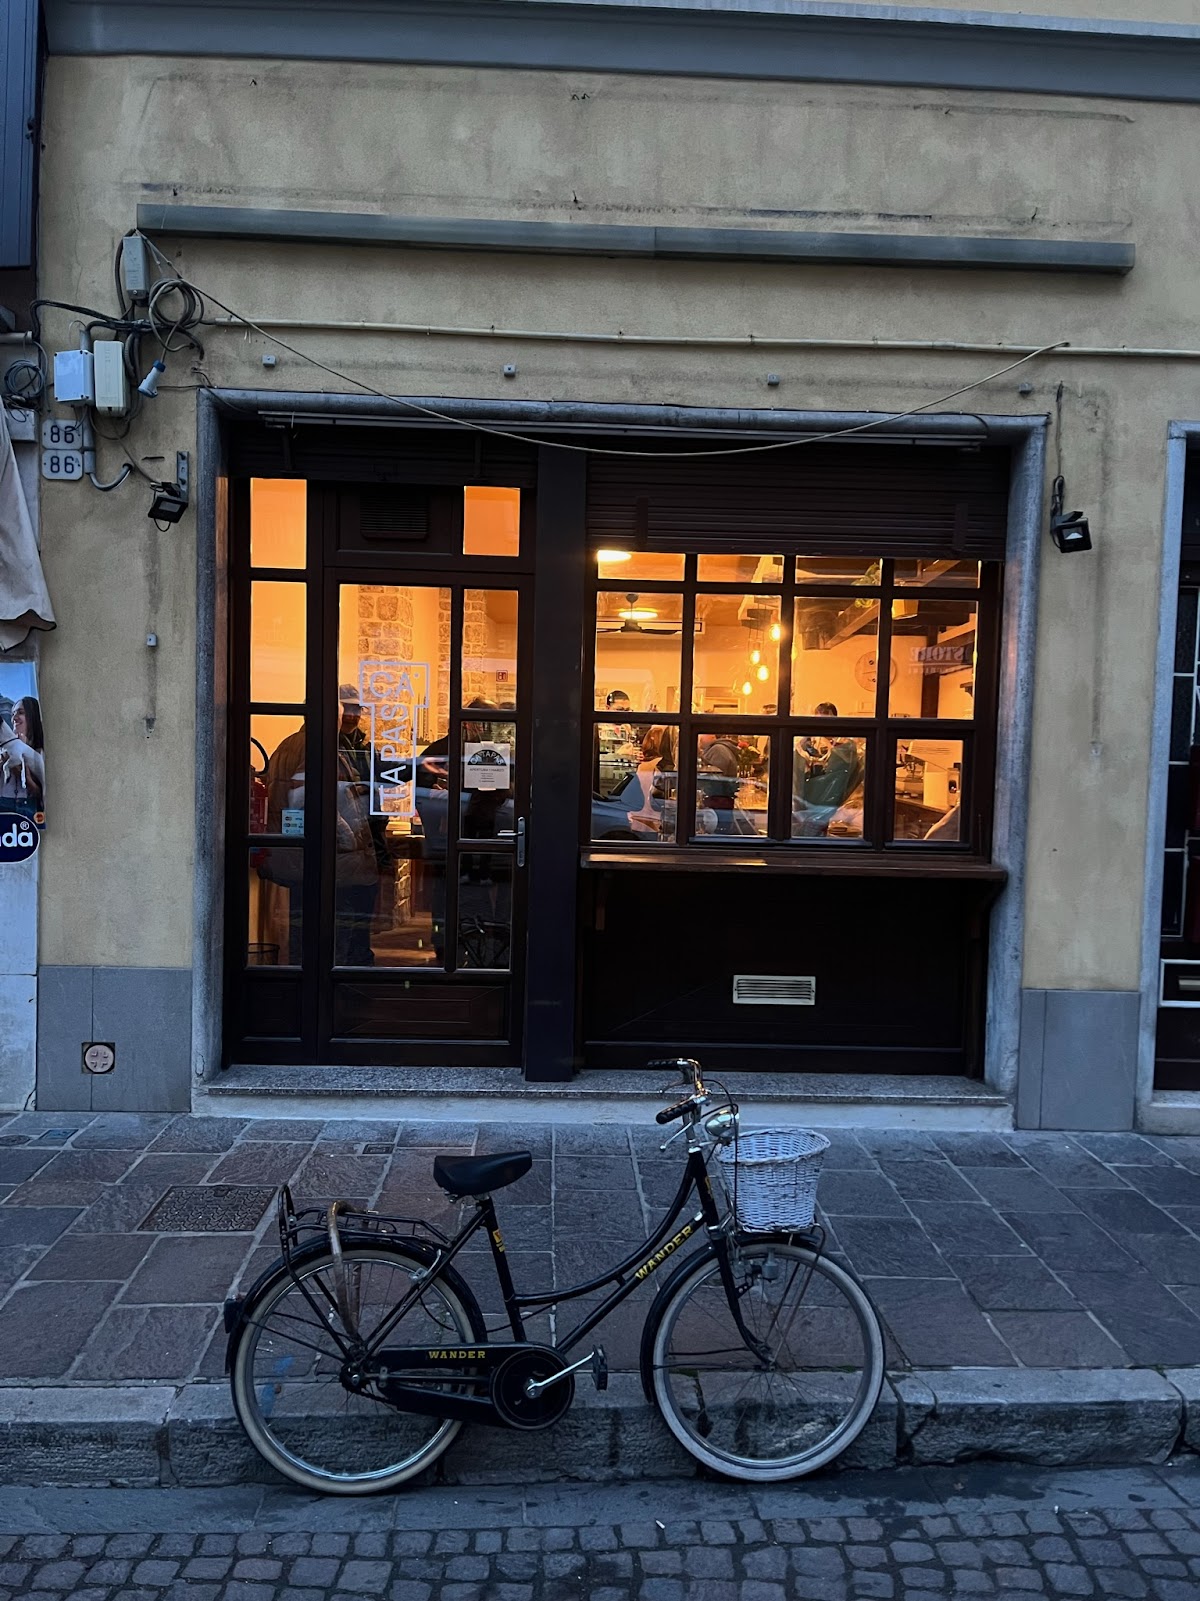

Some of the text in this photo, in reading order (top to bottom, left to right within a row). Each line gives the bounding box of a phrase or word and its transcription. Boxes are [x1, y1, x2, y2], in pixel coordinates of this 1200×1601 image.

[379, 704, 408, 805] TAPAS
[635, 1225, 693, 1279] WANDER
[428, 1351, 486, 1359] WANDER
